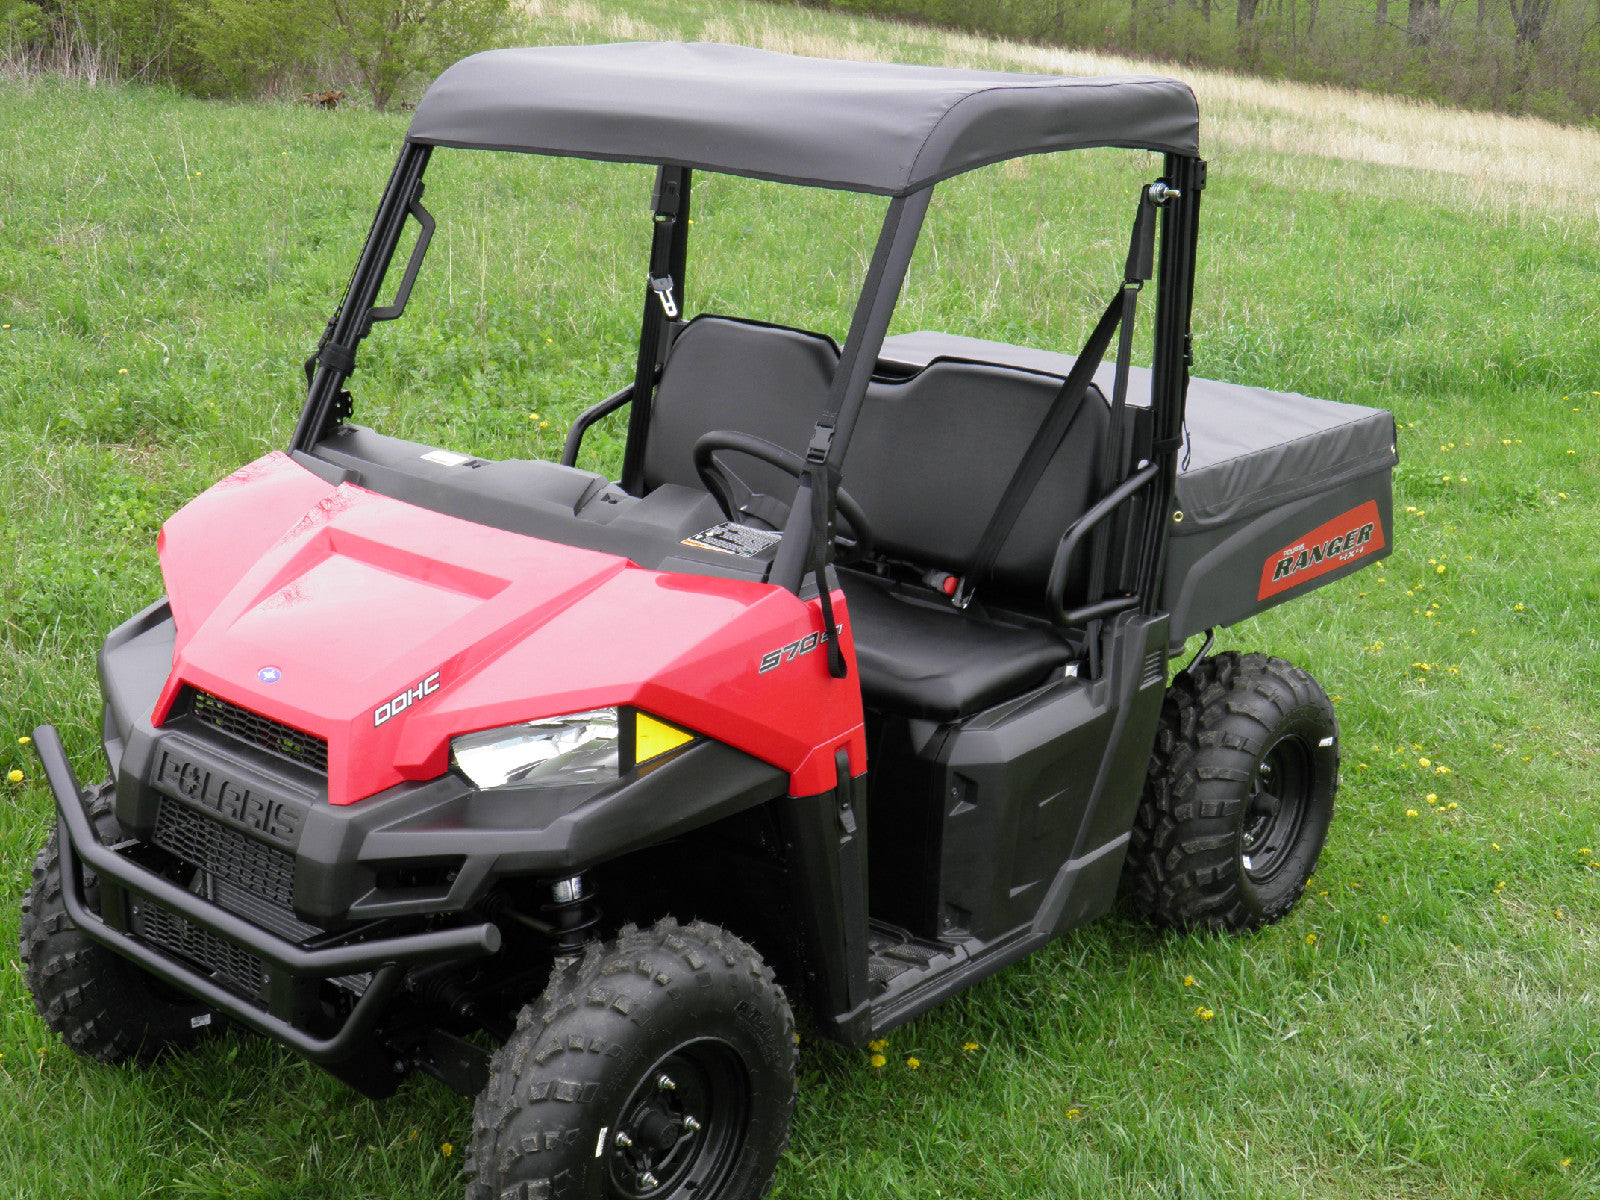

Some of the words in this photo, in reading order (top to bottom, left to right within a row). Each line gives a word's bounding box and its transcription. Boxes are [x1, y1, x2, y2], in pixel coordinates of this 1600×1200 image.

[1272, 521, 1375, 582] RANGER
[759, 631, 819, 675] 570
[820, 623, 844, 644] EI
[374, 670, 440, 728] DOHC
[157, 750, 297, 838] POLARIS
